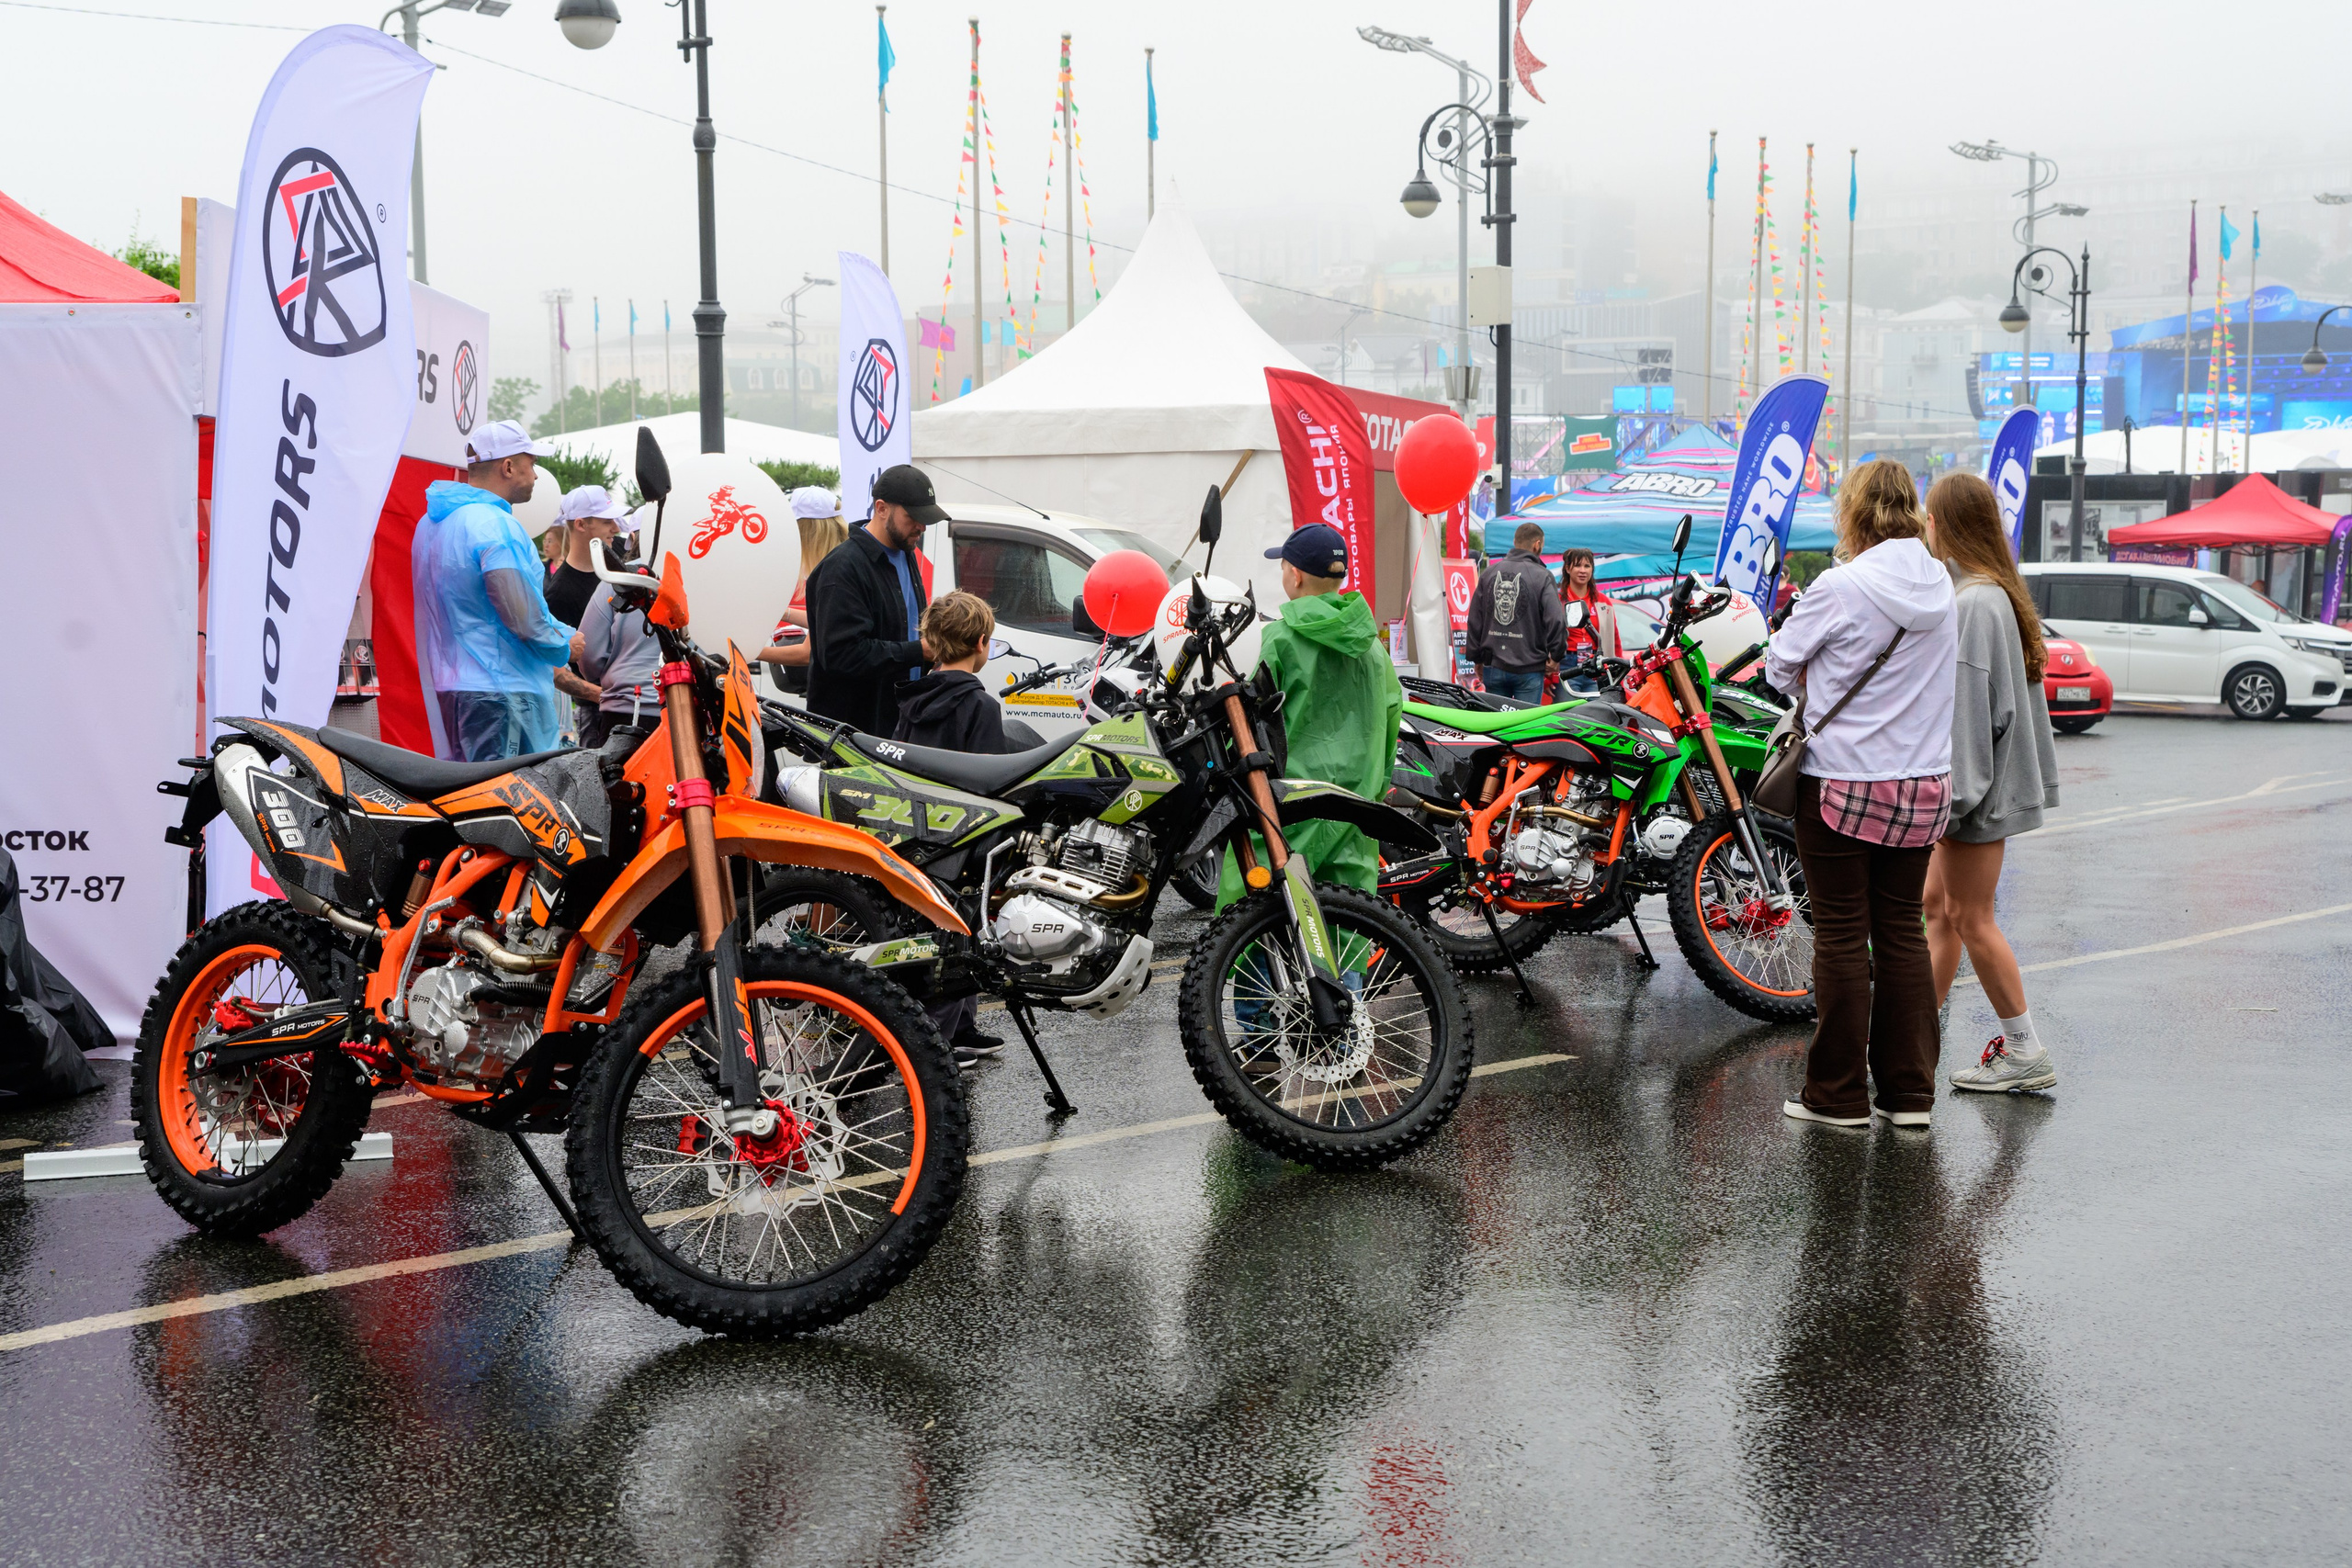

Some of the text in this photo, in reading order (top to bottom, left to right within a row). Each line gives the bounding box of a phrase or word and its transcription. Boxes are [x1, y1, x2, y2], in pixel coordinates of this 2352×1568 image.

[1727, 495, 1743, 528] TRUSTED
[1742, 470, 1753, 494] NAME
[1751, 422, 1774, 468] WORLDWIDE
[1611, 472, 1718, 497] ABRO
[1005, 710, 1082, 719] www.mcmauto.ru
[1084, 734, 1141, 743] SPRMOTORS
[876, 741, 906, 761] SPR
[361, 788, 407, 814] MAX
[839, 788, 872, 801] SM
[256, 813, 270, 832] SPR
[262, 791, 306, 849] 300
[0, 830, 90, 851] СТОК
[1659, 832, 1675, 840] SPR
[1520, 844, 1536, 852] SPR
[1390, 869, 1430, 884] SPR MOTORS
[1031, 923, 1065, 934] SPR
[1302, 897, 1325, 959] SPRMOTORS
[412, 995, 431, 1005] SPR
[272, 1019, 325, 1037] SPR MOTORS
